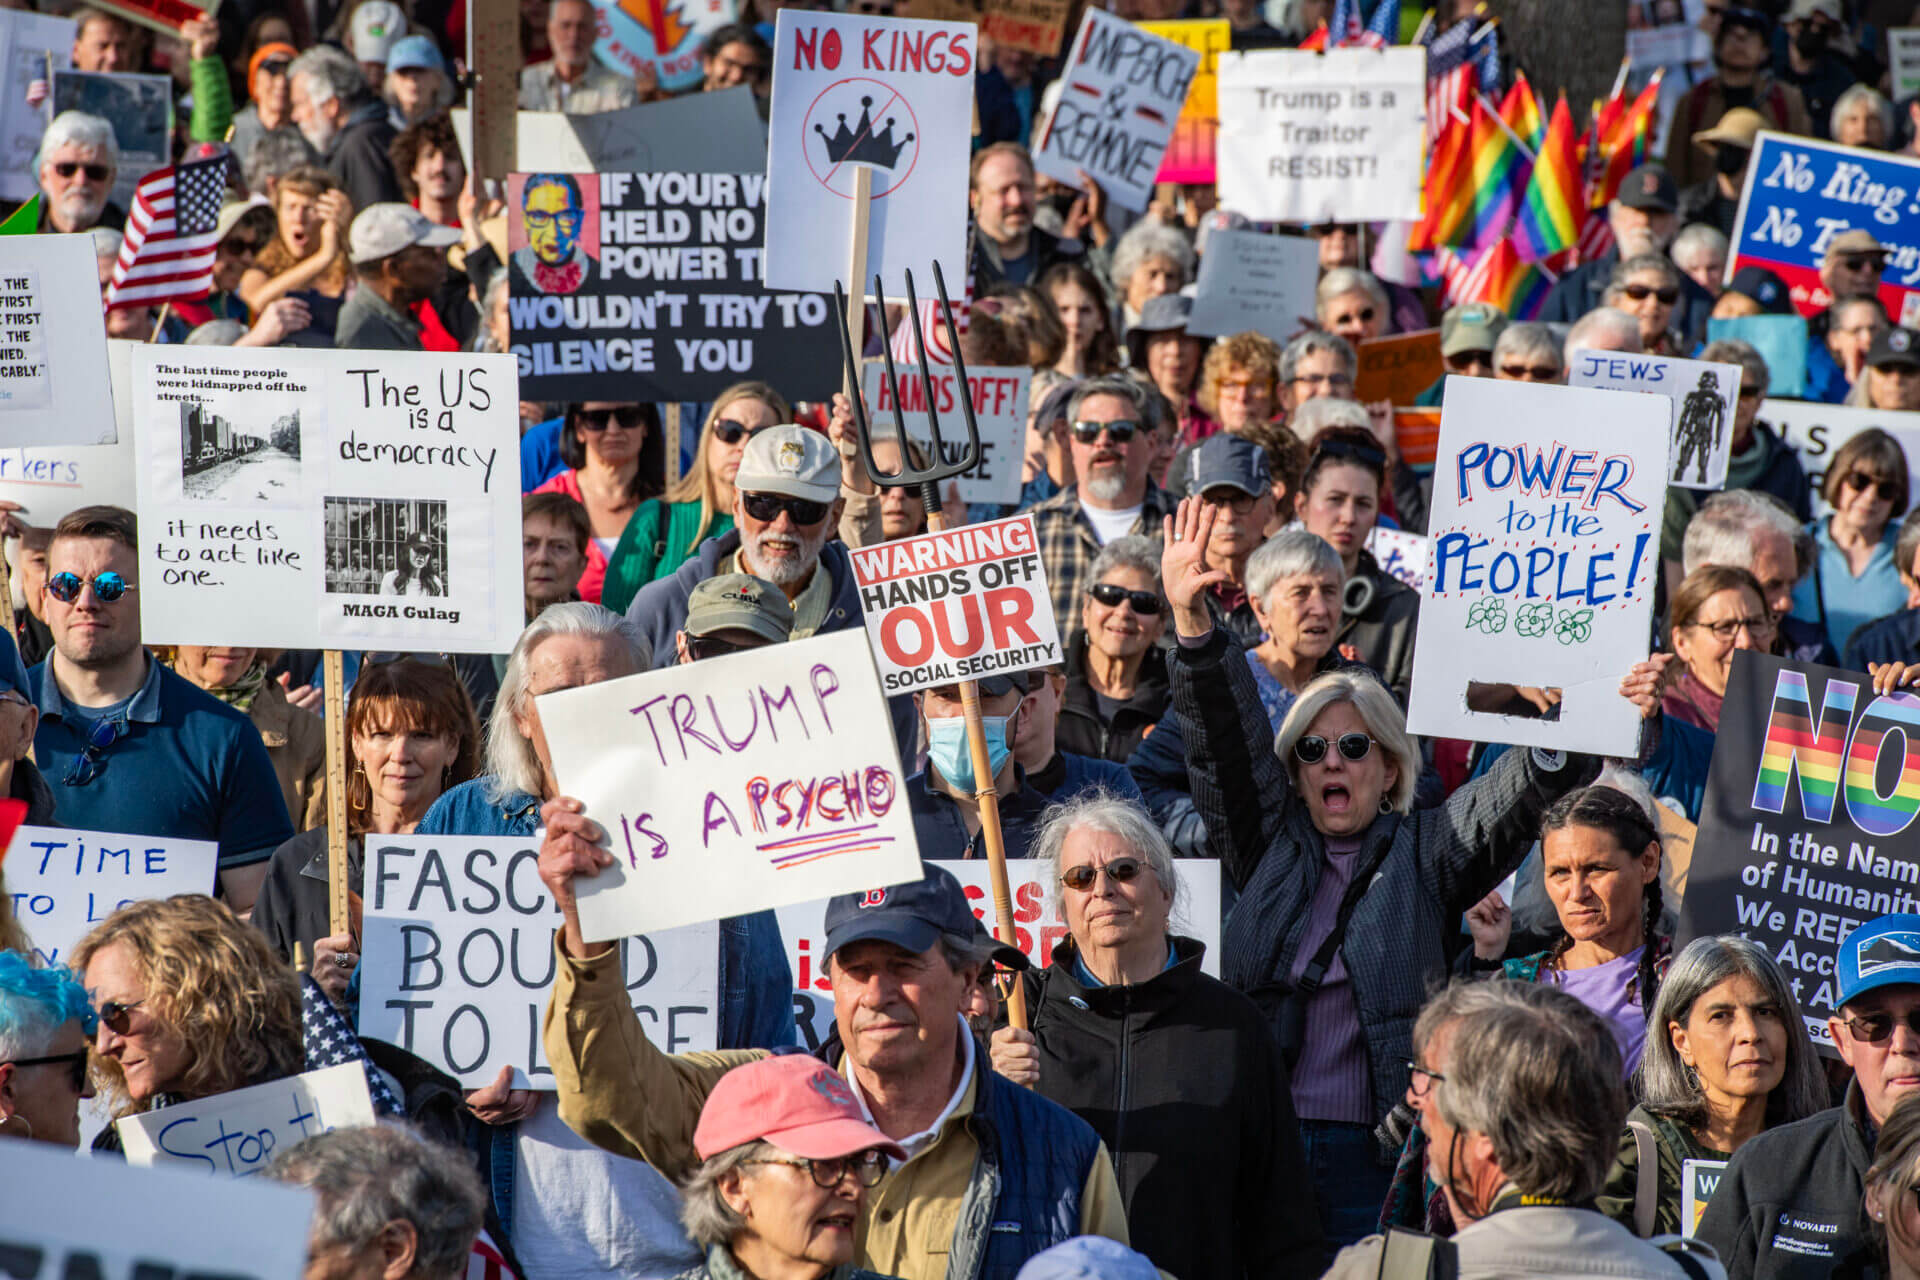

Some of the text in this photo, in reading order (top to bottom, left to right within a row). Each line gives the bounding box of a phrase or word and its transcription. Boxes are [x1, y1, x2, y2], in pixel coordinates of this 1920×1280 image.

[795, 26, 842, 71] NO
[863, 28, 973, 77] KINGS
[1104, 83, 1127, 121] &
[1255, 85, 1396, 115] Trump is a
[1042, 100, 1166, 190] REMOVE
[1279, 121, 1371, 144] Traitor
[1268, 155, 1379, 179] RESIST!
[1762, 150, 1816, 194] No
[599, 171, 768, 208] IF YOUR V
[600, 208, 755, 244] HELD NO
[1750, 204, 1803, 248] No
[599, 246, 728, 280] POWER
[4, 278, 29, 290] THE
[5, 313, 41, 325] FIRST
[508, 290, 828, 330] WOULDN'T TRY TO
[6, 330, 31, 342] THE
[156, 364, 288, 379] The last time people
[517, 338, 753, 378] SILENCE YOU
[1582, 357, 1668, 382] JEWS
[156, 379, 308, 392] were kidnapped off the
[157, 392, 215, 403] streets...
[346, 368, 491, 411] The US
[878, 372, 1019, 416] HANDS OFF!
[409, 408, 457, 434] is a
[340, 430, 497, 493] democracy
[1456, 439, 1648, 516] POWER
[168, 519, 279, 540] it needs
[1497, 500, 1604, 538] to the
[156, 543, 302, 571] to act like
[854, 521, 1032, 582] WARNING
[1434, 532, 1651, 606] PEOPLE!
[163, 568, 225, 586] one.
[861, 554, 1038, 613] HANDS OFF
[343, 604, 460, 624] MAGA Gulag
[880, 586, 1042, 668] OUR
[885, 642, 1056, 690] SOCIAL SECURITY
[629, 663, 840, 766] TRUMP
[1751, 668, 1920, 836] NO
[621, 765, 896, 870] IS A PSYCHO
[1751, 821, 1779, 856] In
[1789, 832, 1838, 866] the
[1742, 861, 1778, 889] of
[11, 893, 55, 919] TO
[1736, 894, 1786, 931] We
[398, 924, 658, 991] BOUD
[385, 999, 491, 1075] TO
[1792, 1219, 1838, 1234] NOVARTIS
